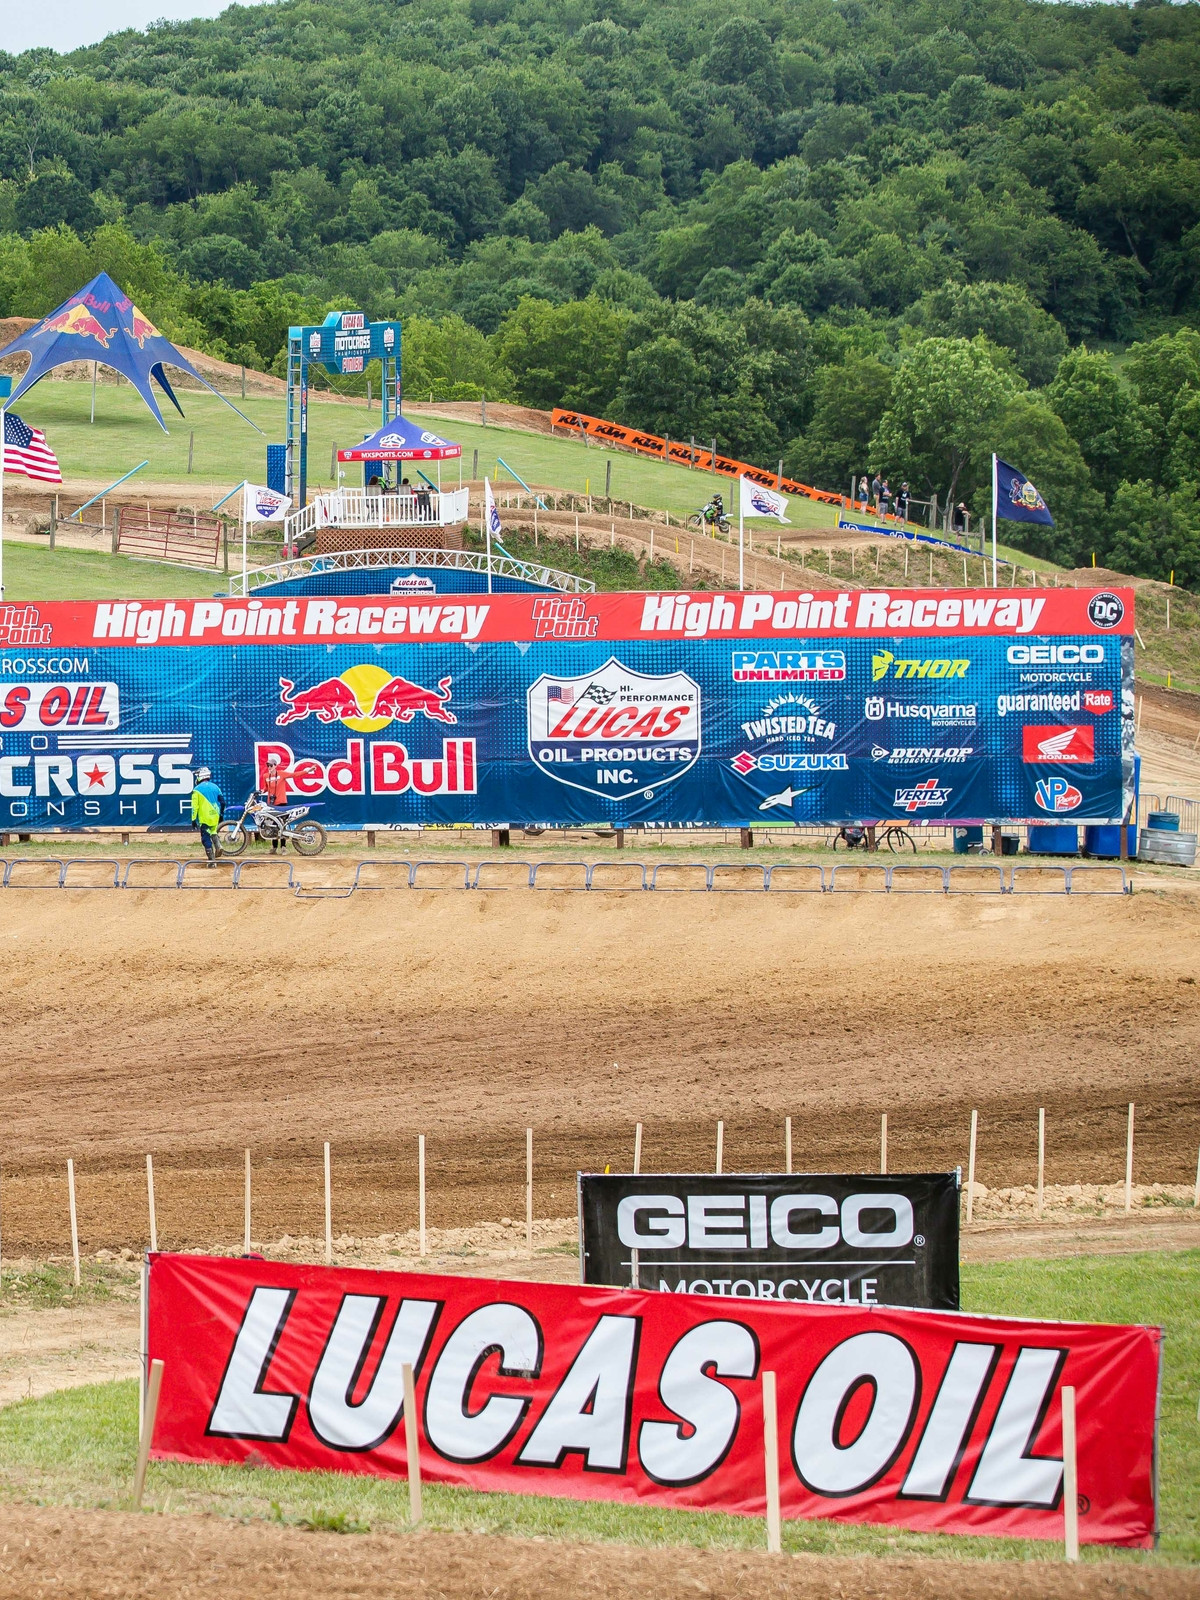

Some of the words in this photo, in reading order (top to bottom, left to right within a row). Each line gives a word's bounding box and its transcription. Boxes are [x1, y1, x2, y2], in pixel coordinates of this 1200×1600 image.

[84, 293, 111, 313] Bull
[343, 315, 356, 328] LUCAS
[335, 335, 370, 350] MOTOCROSS
[342, 357, 363, 373] FINISH
[558, 414, 589, 429] KTM
[595, 424, 627, 440] KTM
[632, 436, 664, 451] KTM
[706, 459, 738, 474] KTM
[743, 470, 775, 487] KTM
[532, 598, 585, 621] High
[640, 594, 737, 638] High
[739, 593, 850, 630] Point
[856, 594, 1046, 633] Raceway
[1094, 600, 1118, 621] DC
[93, 602, 185, 644] High
[190, 600, 299, 636] Point
[303, 600, 490, 640] Raceway
[535, 616, 599, 638] Point
[733, 652, 845, 669] PARTS
[1007, 645, 1104, 664] GEICO
[734, 669, 845, 681] UNLIMITED
[894, 659, 970, 678] THOR
[1020, 673, 1092, 682] MOTORCYCLE
[38, 685, 110, 727] OIL
[887, 702, 976, 720] Husqvarna
[997, 691, 1080, 717] guaranteed
[1085, 693, 1111, 706] Rate
[548, 706, 690, 738] LUCAS
[741, 716, 806, 740] TWISTED
[808, 715, 836, 740] TEA
[538, 748, 573, 762] OIL
[581, 747, 692, 762] PRODUCTS
[757, 753, 849, 772] SUZUKI
[891, 748, 973, 758] DUNLOP
[255, 738, 367, 796] Red
[371, 737, 478, 795] Bull
[597, 769, 638, 784] INC.
[895, 788, 951, 801] VERTEX
[1036, 777, 1068, 810] VP
[617, 1193, 913, 1249] GEICO
[205, 1286, 761, 1488] LUCAS
[792, 1330, 1068, 1510] OIL
